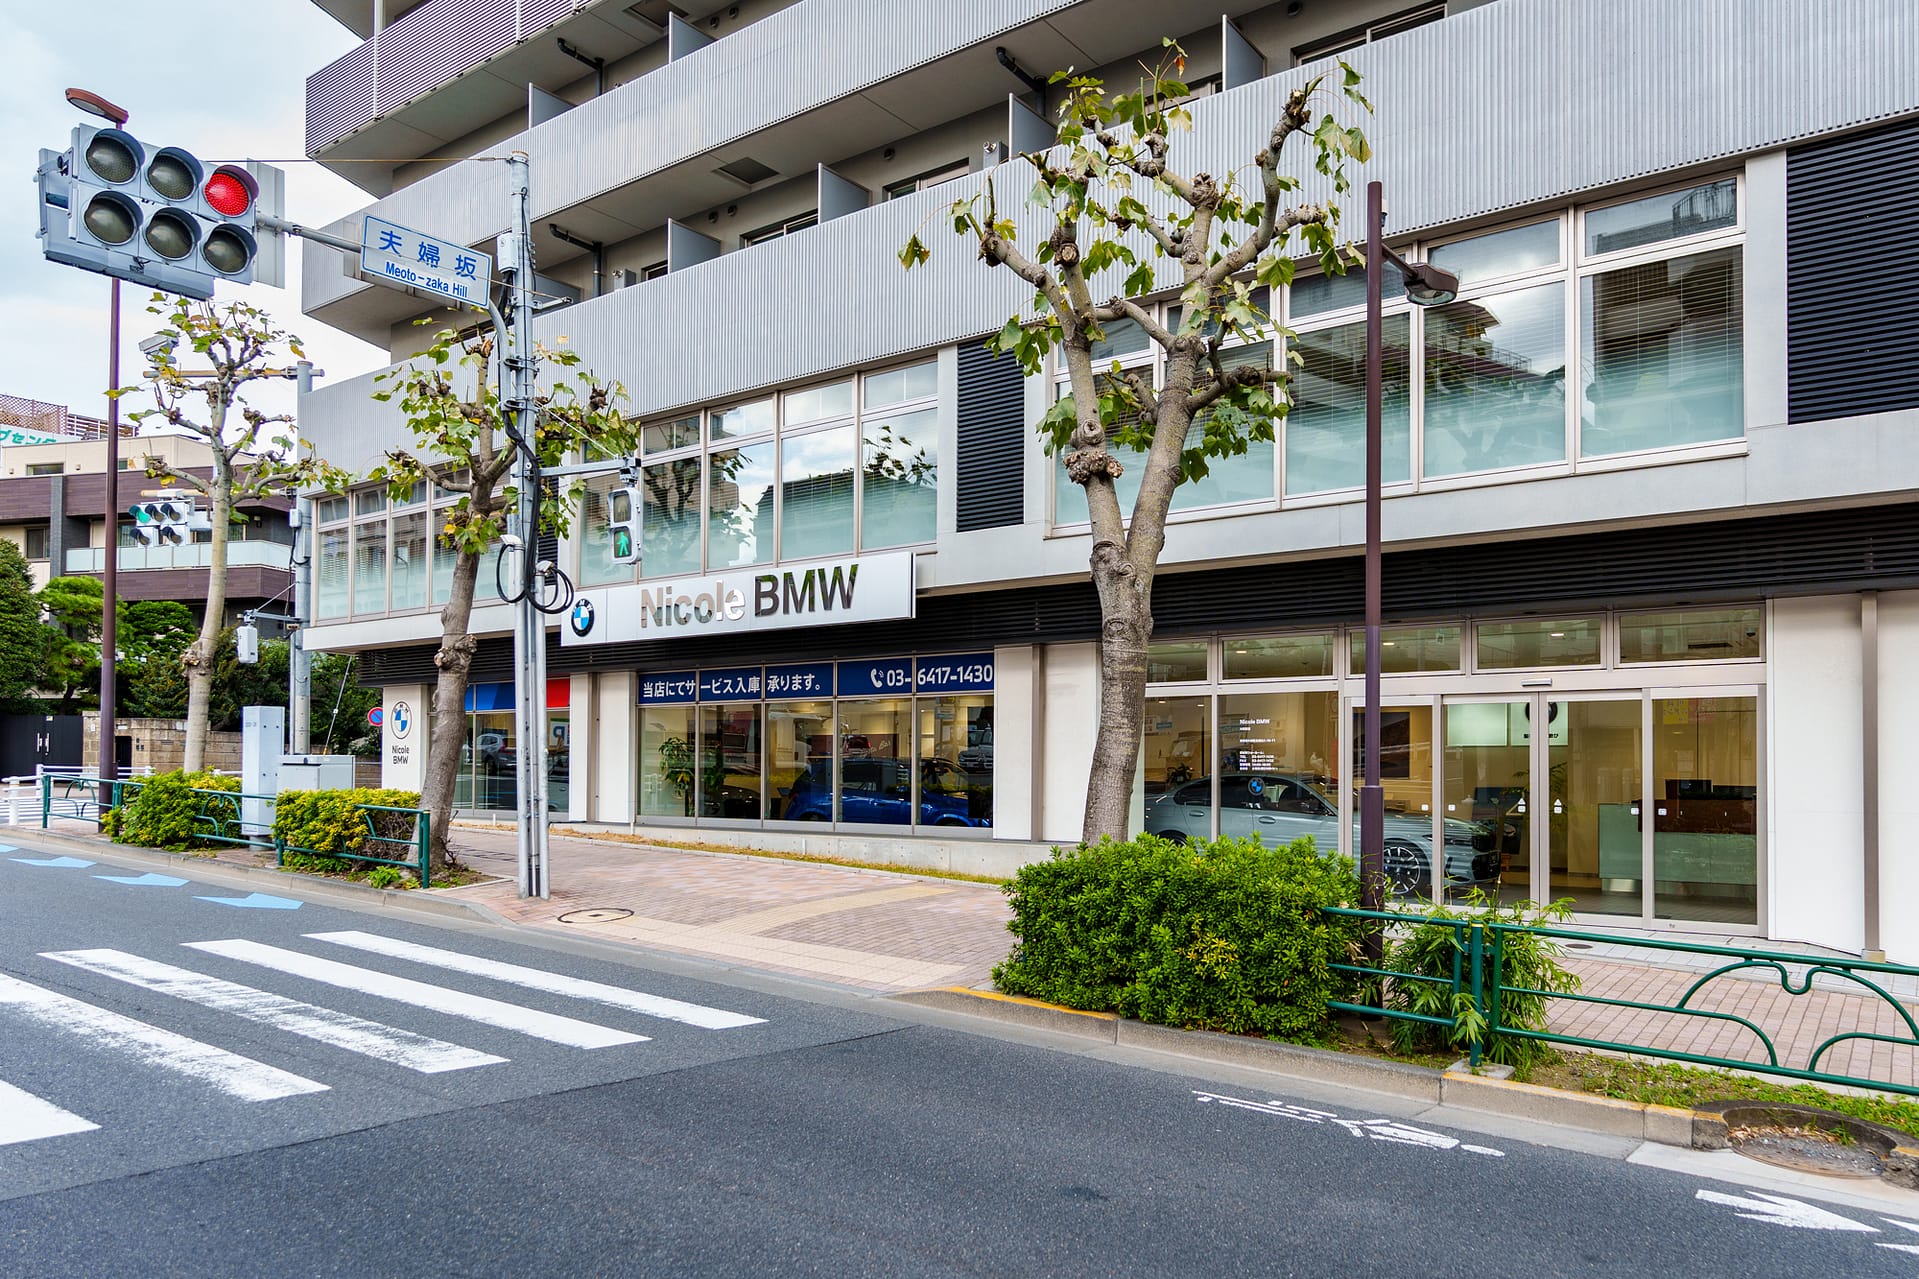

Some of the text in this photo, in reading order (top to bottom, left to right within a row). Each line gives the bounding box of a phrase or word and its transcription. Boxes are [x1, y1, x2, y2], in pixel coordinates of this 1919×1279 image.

[379, 230, 477, 281] 夫婦坂
[452, 282, 468, 299] Hill
[641, 563, 859, 628] Nicole BMW
[391, 745, 409, 754] Nicole
[393, 755, 409, 765] BMW
